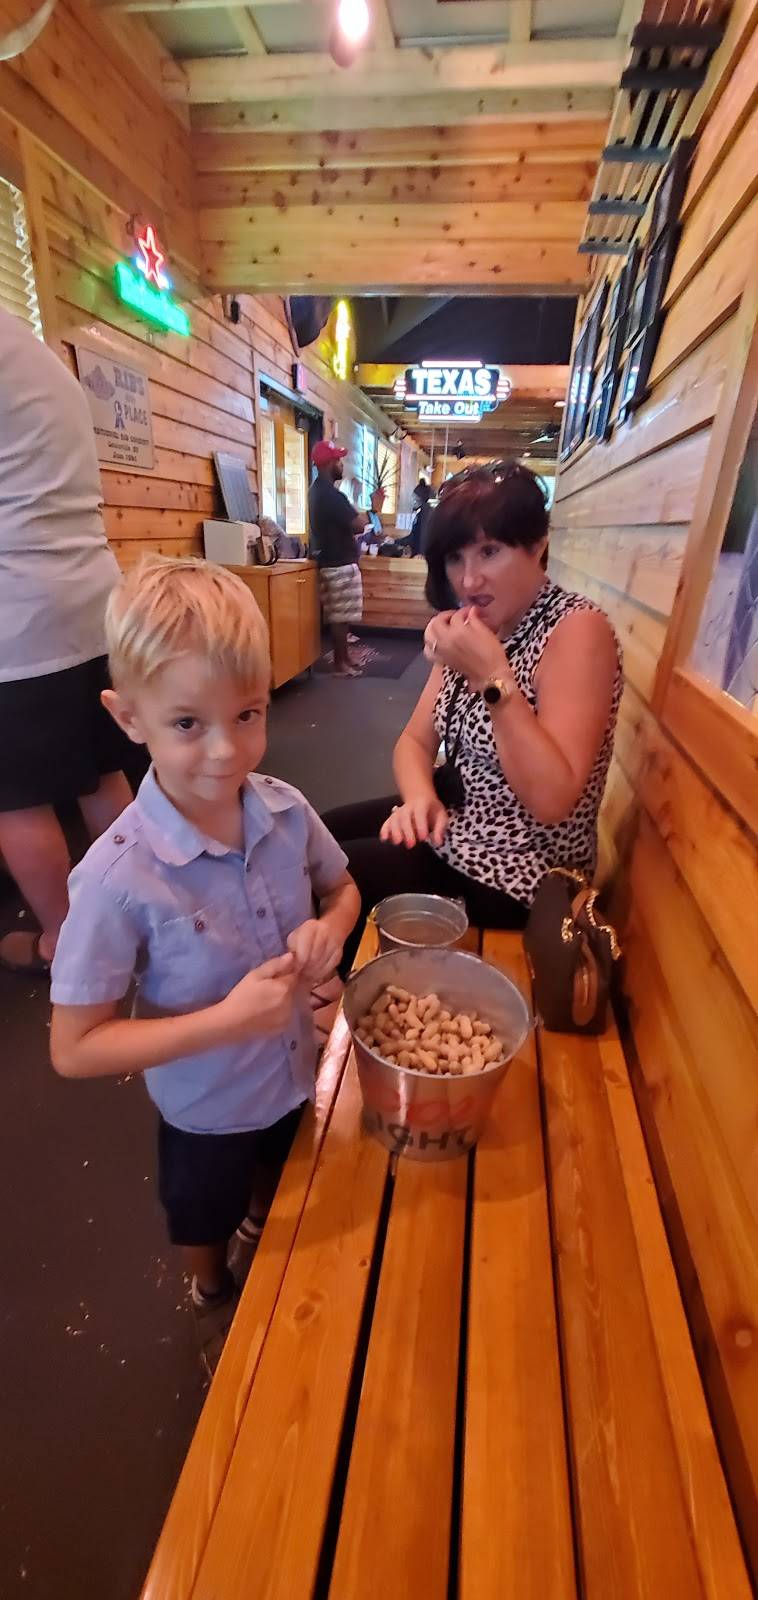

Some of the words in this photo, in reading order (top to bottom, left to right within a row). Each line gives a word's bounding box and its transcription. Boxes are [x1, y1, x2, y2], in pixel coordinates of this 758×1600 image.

[412, 369, 491, 395] TEXAS
[124, 404, 148, 426] PLACE
[419, 401, 451, 415] Take
[454, 401, 479, 415] Out
[362, 1108, 473, 1151] IGHT
